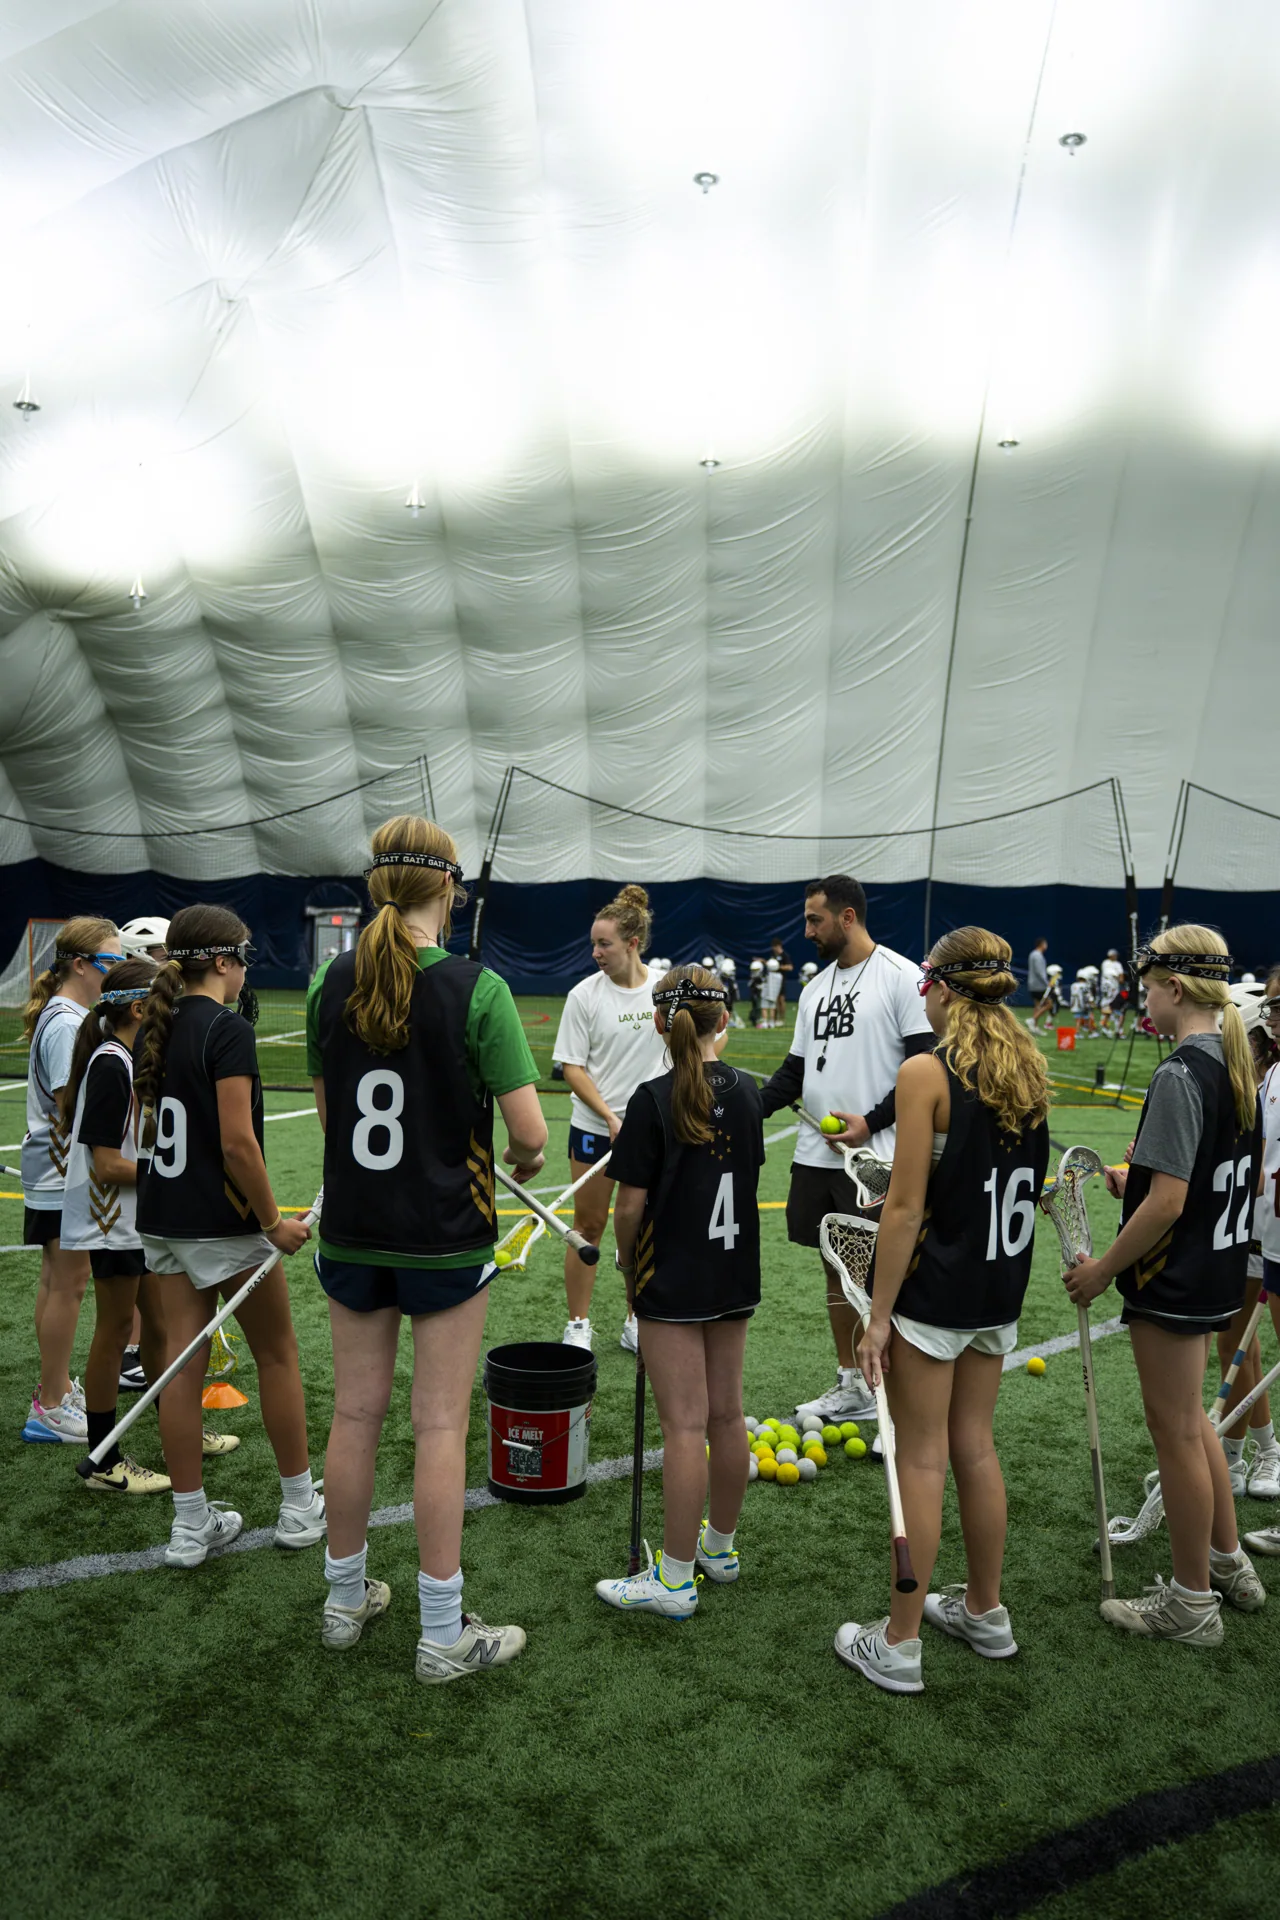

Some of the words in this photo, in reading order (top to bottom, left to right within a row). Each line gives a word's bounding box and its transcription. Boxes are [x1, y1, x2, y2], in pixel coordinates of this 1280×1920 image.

[380, 856, 400, 864] GAIT
[403, 856, 425, 865] GAIT
[428, 860, 445, 868] GAIT
[972, 960, 998, 969] STX
[1205, 955, 1226, 963] STX
[1199, 968, 1223, 979] STX
[665, 989, 684, 998] GAIT
[817, 991, 861, 1016] LAX
[618, 1013, 634, 1022] LAX
[637, 1012, 652, 1021] LAB
[814, 1013, 854, 1041] LAB
[352, 1069, 404, 1171] 8
[582, 1134, 595, 1154] C
[708, 1172, 739, 1250] 4
[1212, 1154, 1252, 1250] 22
[983, 1167, 1035, 1261] 16
[247, 1270, 267, 1293] GAIT
[508, 1427, 519, 1438] ICE
[522, 1430, 543, 1441] MELT
